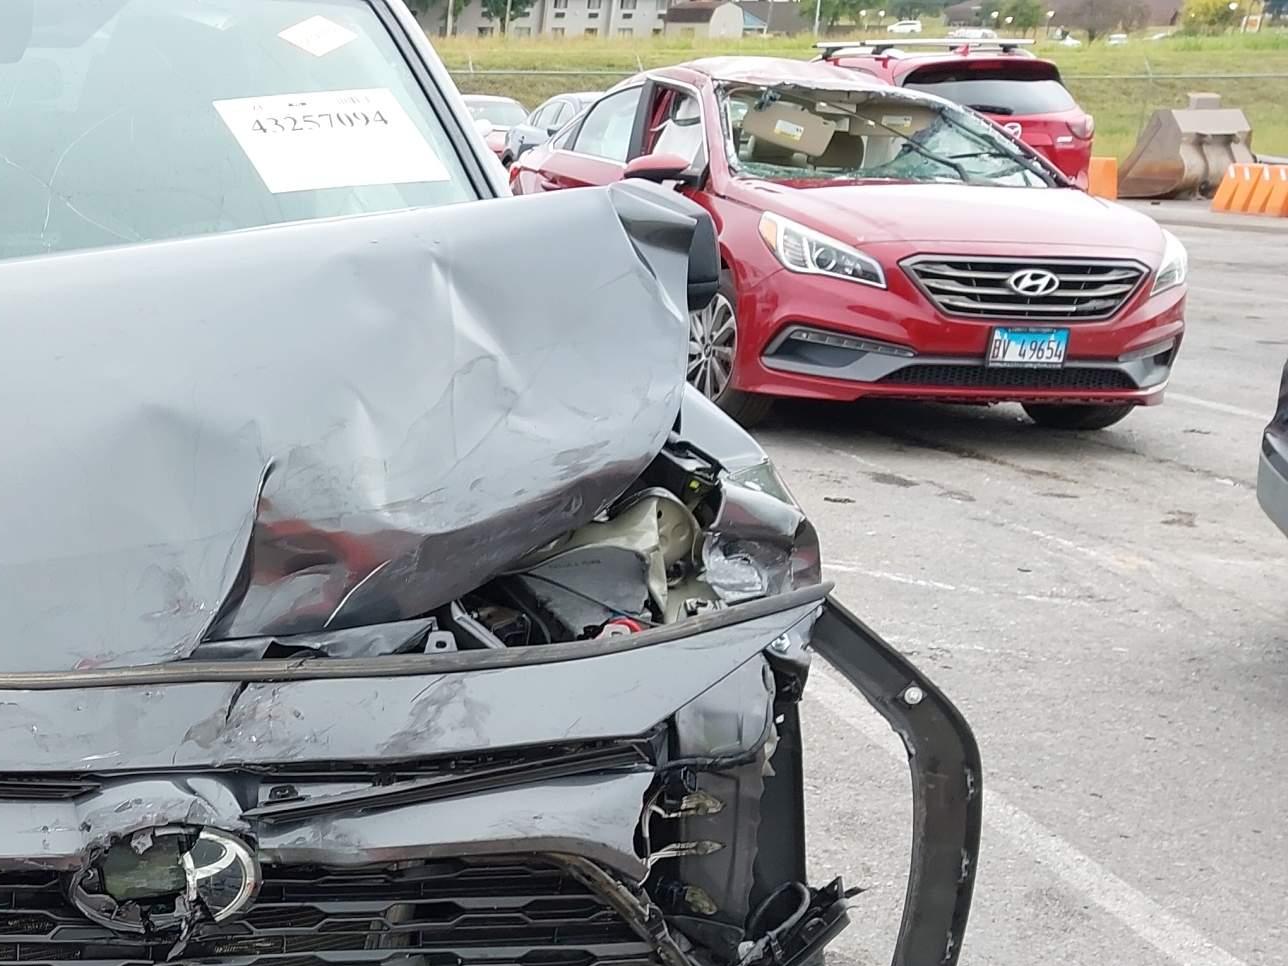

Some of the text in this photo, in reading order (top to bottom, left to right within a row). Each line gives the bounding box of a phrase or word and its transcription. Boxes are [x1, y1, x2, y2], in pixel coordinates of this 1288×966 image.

[252, 110, 389, 133] 43257094
[991, 339, 1063, 360] BV 49654
